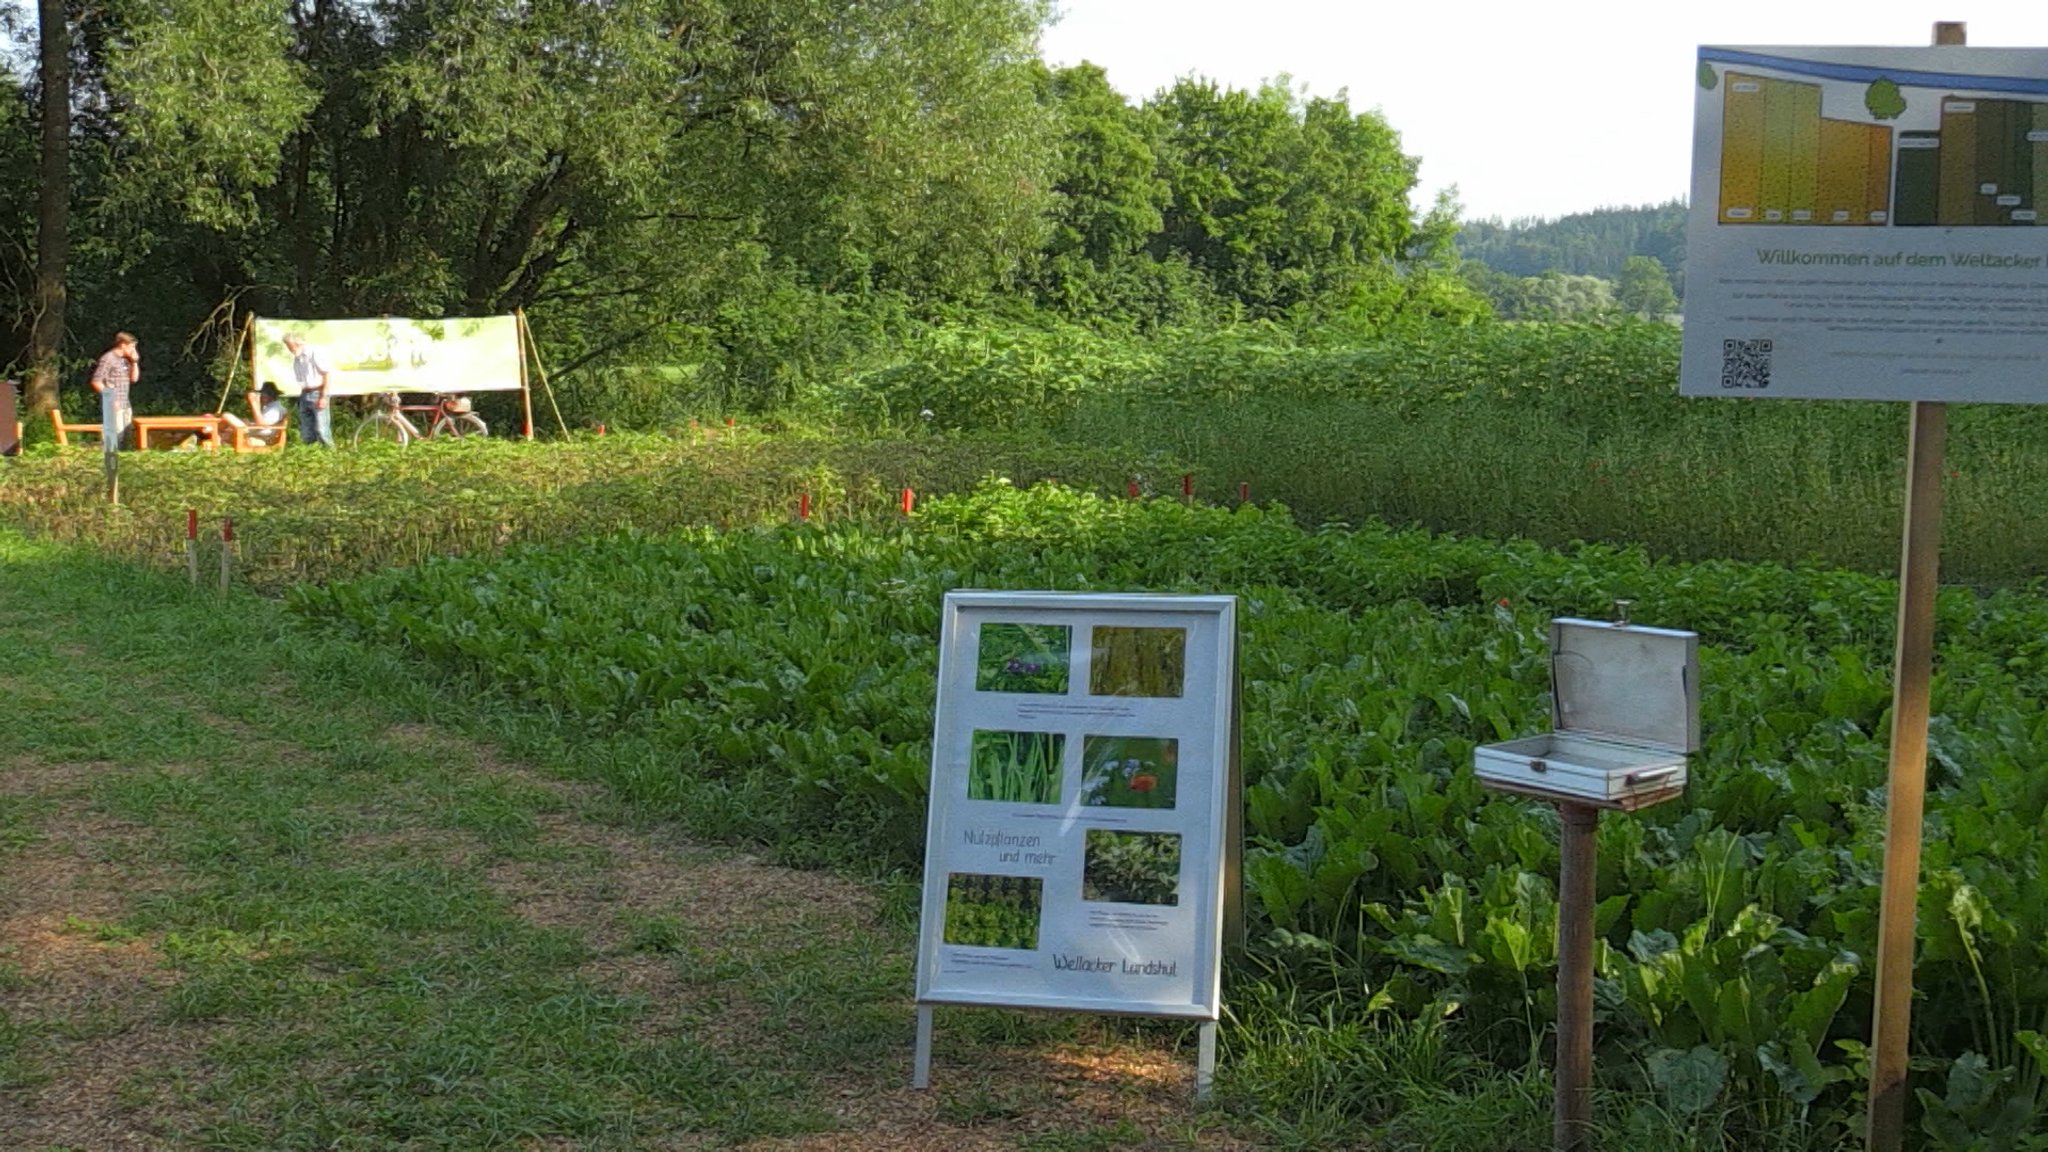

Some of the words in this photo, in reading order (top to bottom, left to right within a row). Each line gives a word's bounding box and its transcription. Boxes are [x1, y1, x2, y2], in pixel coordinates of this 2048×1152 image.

[1757, 249, 1869, 265] Willkommen
[1873, 252, 1904, 267] auf
[1906, 252, 1946, 267] dem
[1951, 253, 2041, 268] Weltacker
[999, 849, 1020, 863] und
[1024, 850, 1057, 865] mehr
